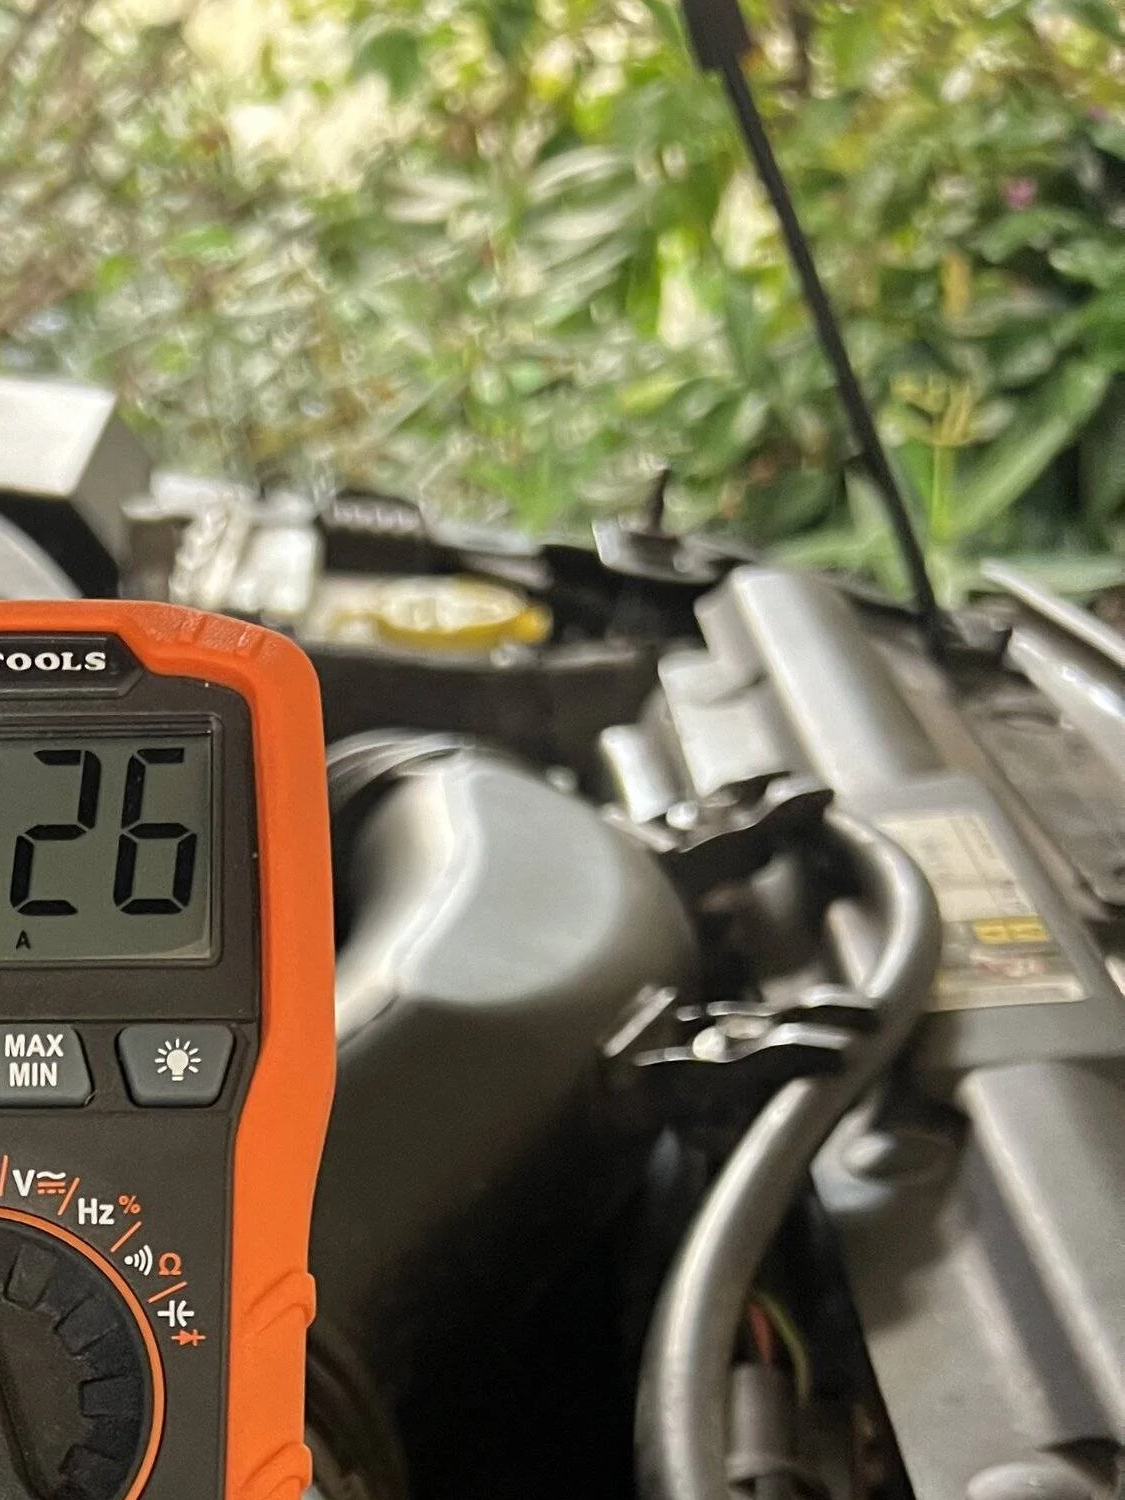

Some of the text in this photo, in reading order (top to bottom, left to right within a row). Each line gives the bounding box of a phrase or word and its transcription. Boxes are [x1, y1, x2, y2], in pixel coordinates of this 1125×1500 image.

[16, 931, 31, 950] A
[4, 1034, 64, 1057] MAX
[9, 1063, 58, 1087] MIN
[78, 1199, 115, 1226] Hz
